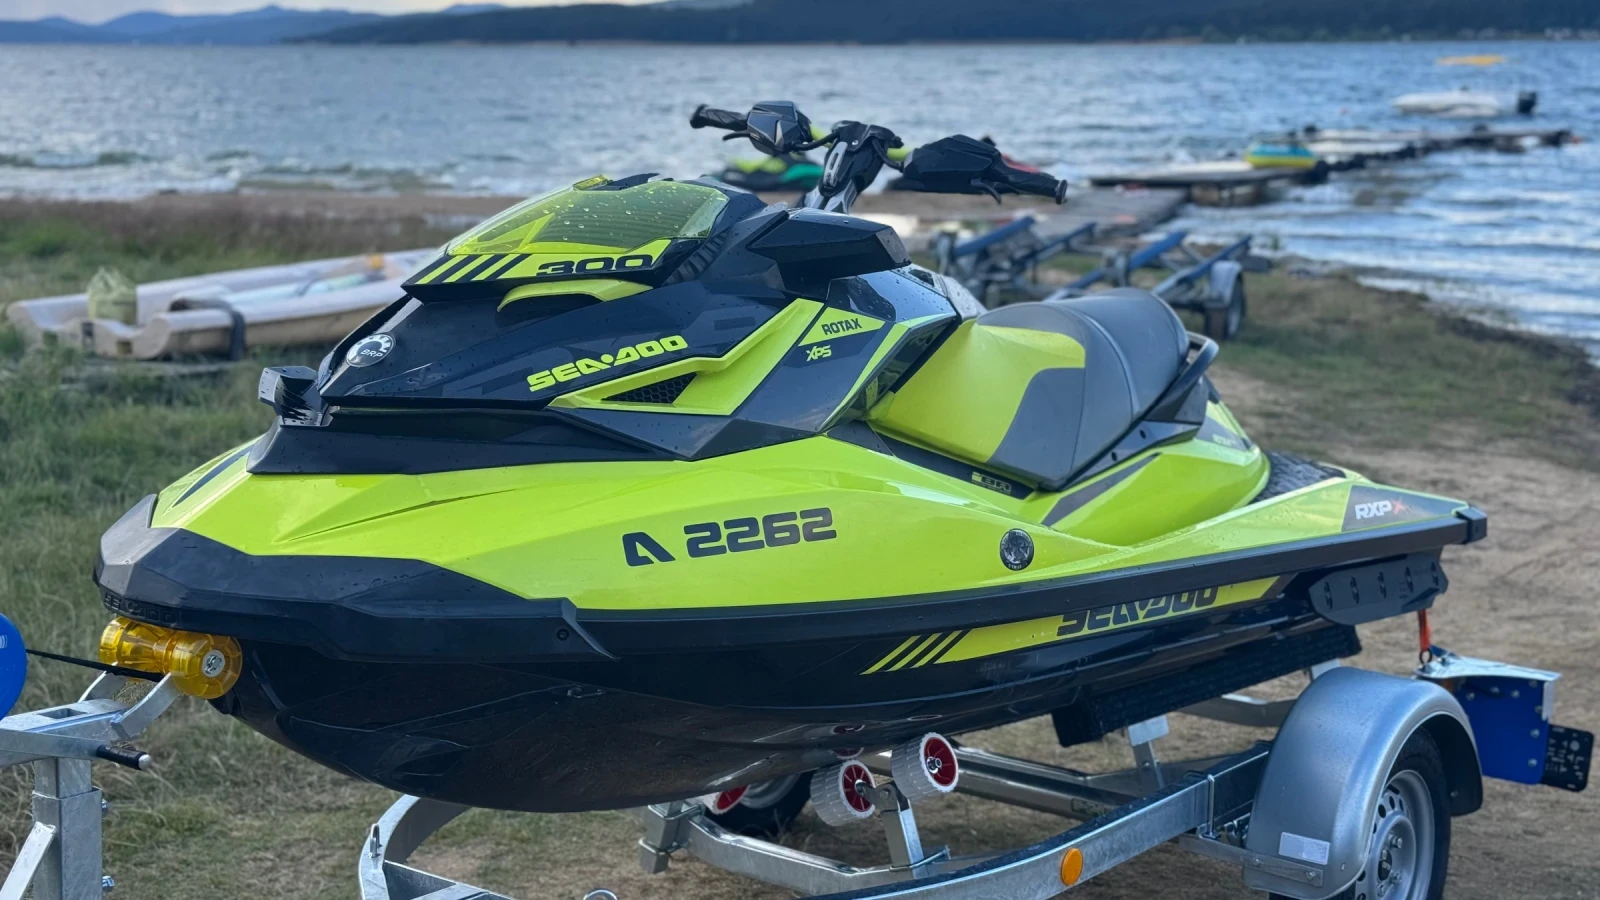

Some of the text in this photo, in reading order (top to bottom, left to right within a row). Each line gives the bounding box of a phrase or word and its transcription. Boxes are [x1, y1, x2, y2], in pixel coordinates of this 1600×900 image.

[536, 254, 653, 277] 300
[821, 317, 862, 335] ROTAX
[360, 348, 384, 357] BRP
[805, 345, 832, 361] XPS
[622, 507, 837, 567] A 2262
